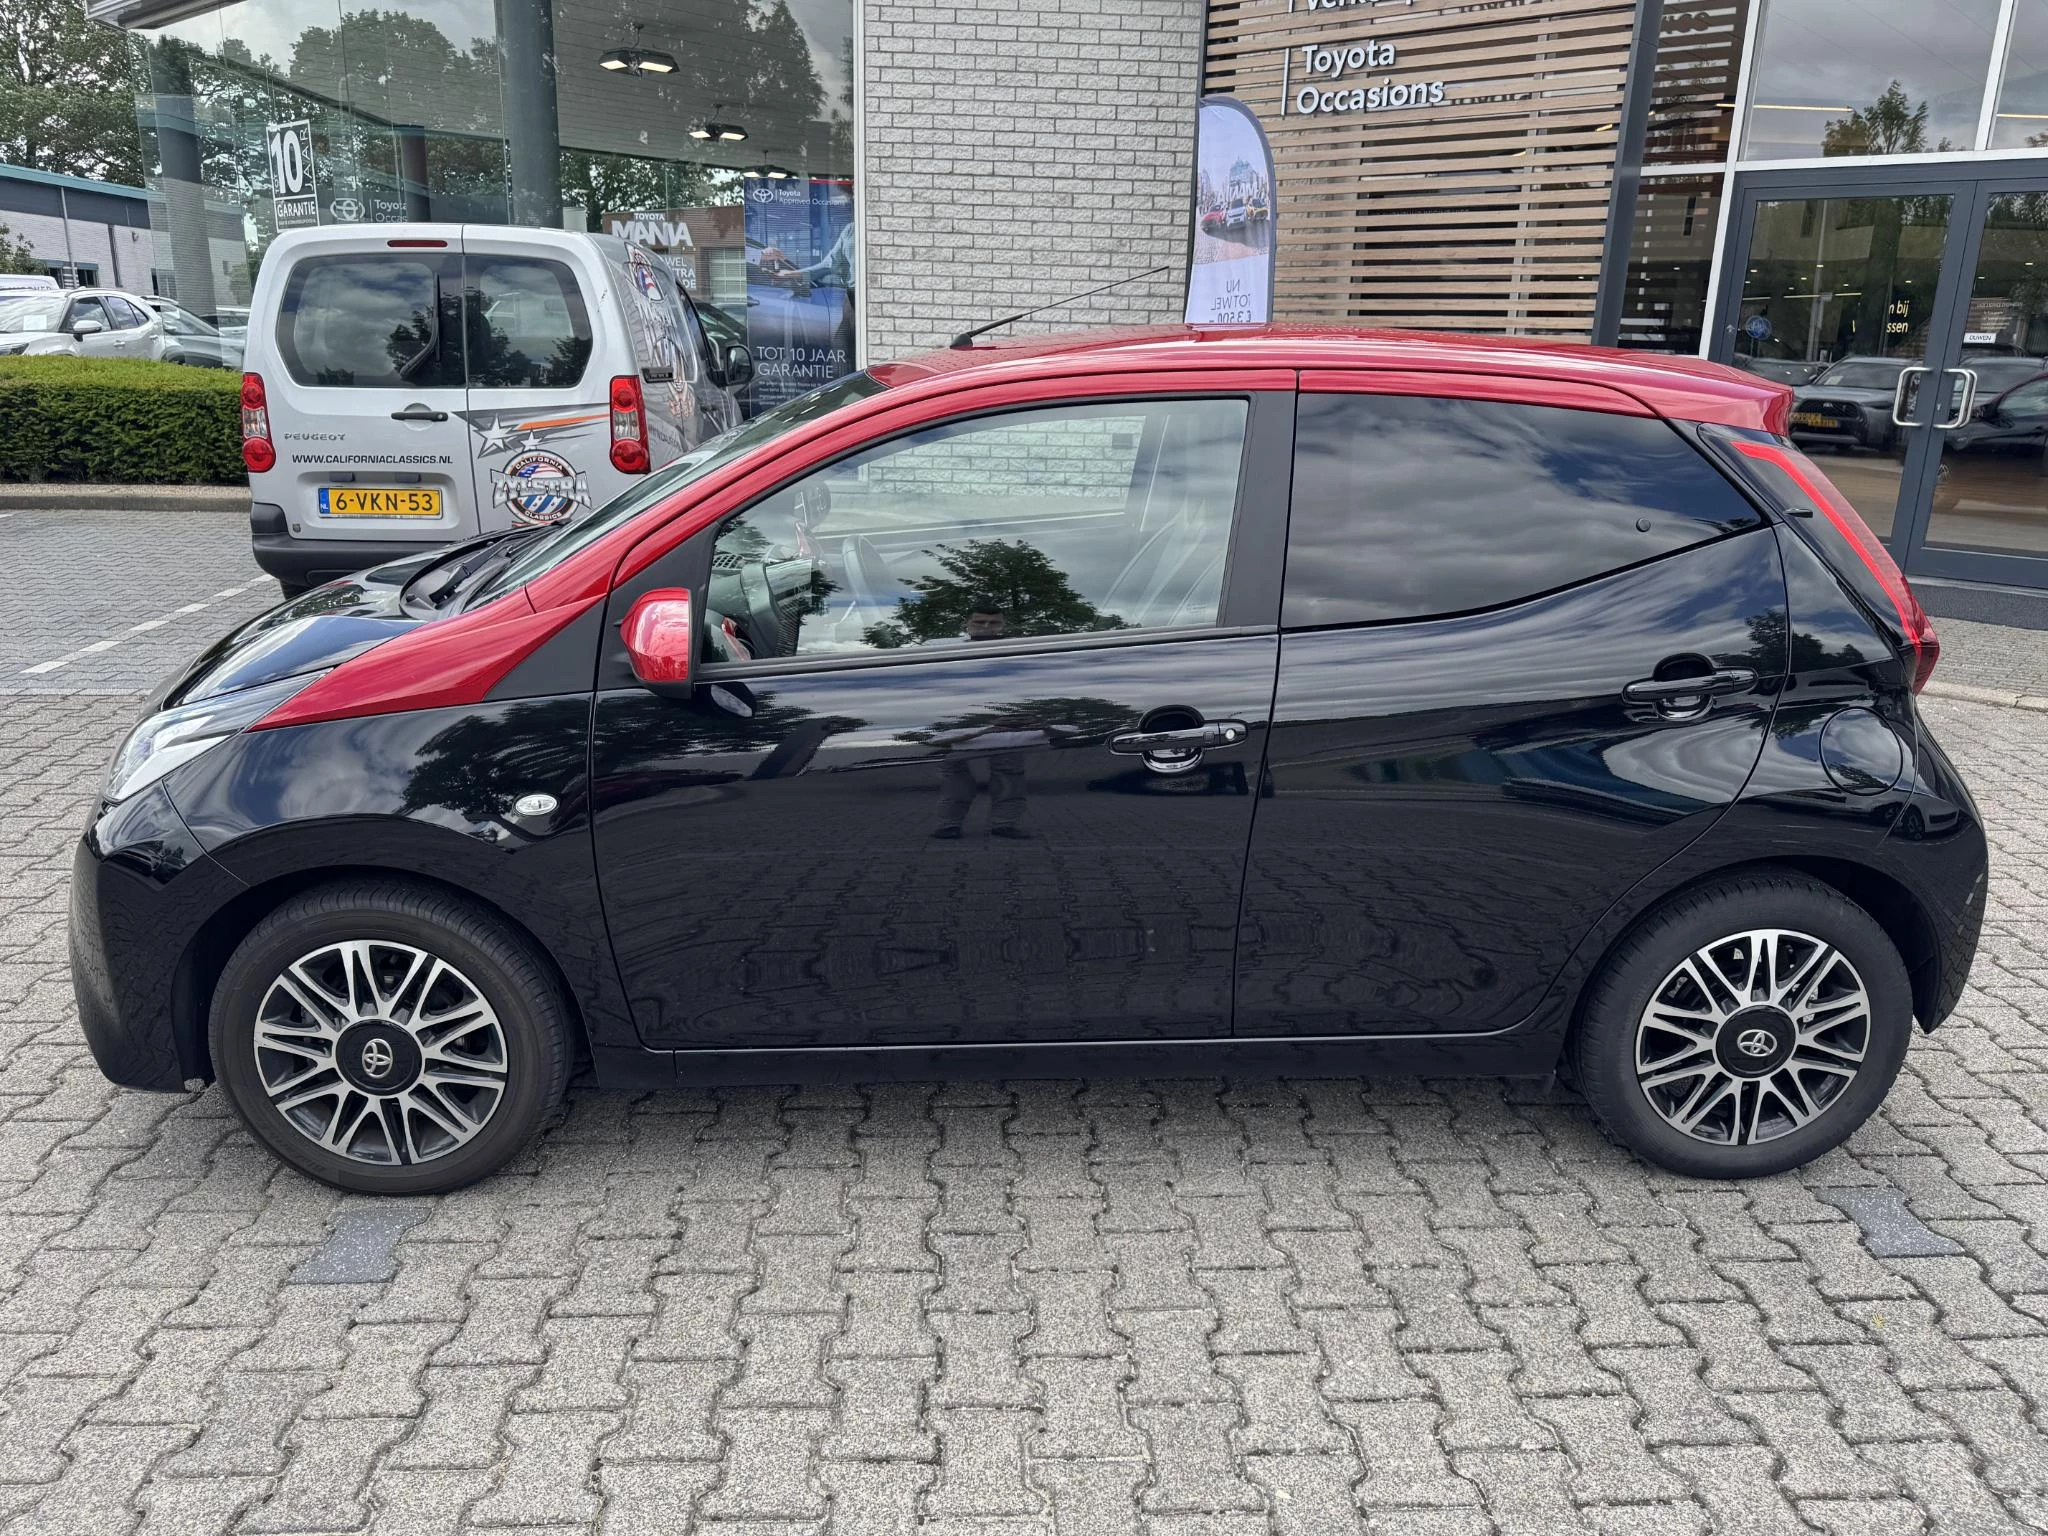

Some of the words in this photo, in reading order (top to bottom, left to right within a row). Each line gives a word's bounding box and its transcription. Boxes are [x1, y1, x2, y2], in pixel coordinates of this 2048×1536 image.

[1302, 39, 1397, 79] Toyota
[1296, 77, 1447, 115] Occasions
[270, 130, 304, 194] 10
[299, 127, 314, 191] JAAR
[779, 188, 801, 198] Toyota
[277, 201, 316, 218] GARANTIE
[376, 212, 408, 223] Occas
[635, 212, 665, 221] TOYOTA
[611, 220, 694, 247] MANIA
[1896, 300, 1910, 318] bij
[756, 346, 785, 361] TOT
[790, 348, 805, 362] 10
[809, 348, 847, 363] JAAR
[757, 362, 834, 379] GARANTIE
[284, 433, 346, 441] PEUGEOT
[292, 454, 453, 464] WWW.CALIFORNIACLASSICS.NL
[515, 456, 563, 471] CALIFORNIA
[335, 492, 433, 512] 6-VKN-53
[525, 510, 562, 521] CLASSICS
